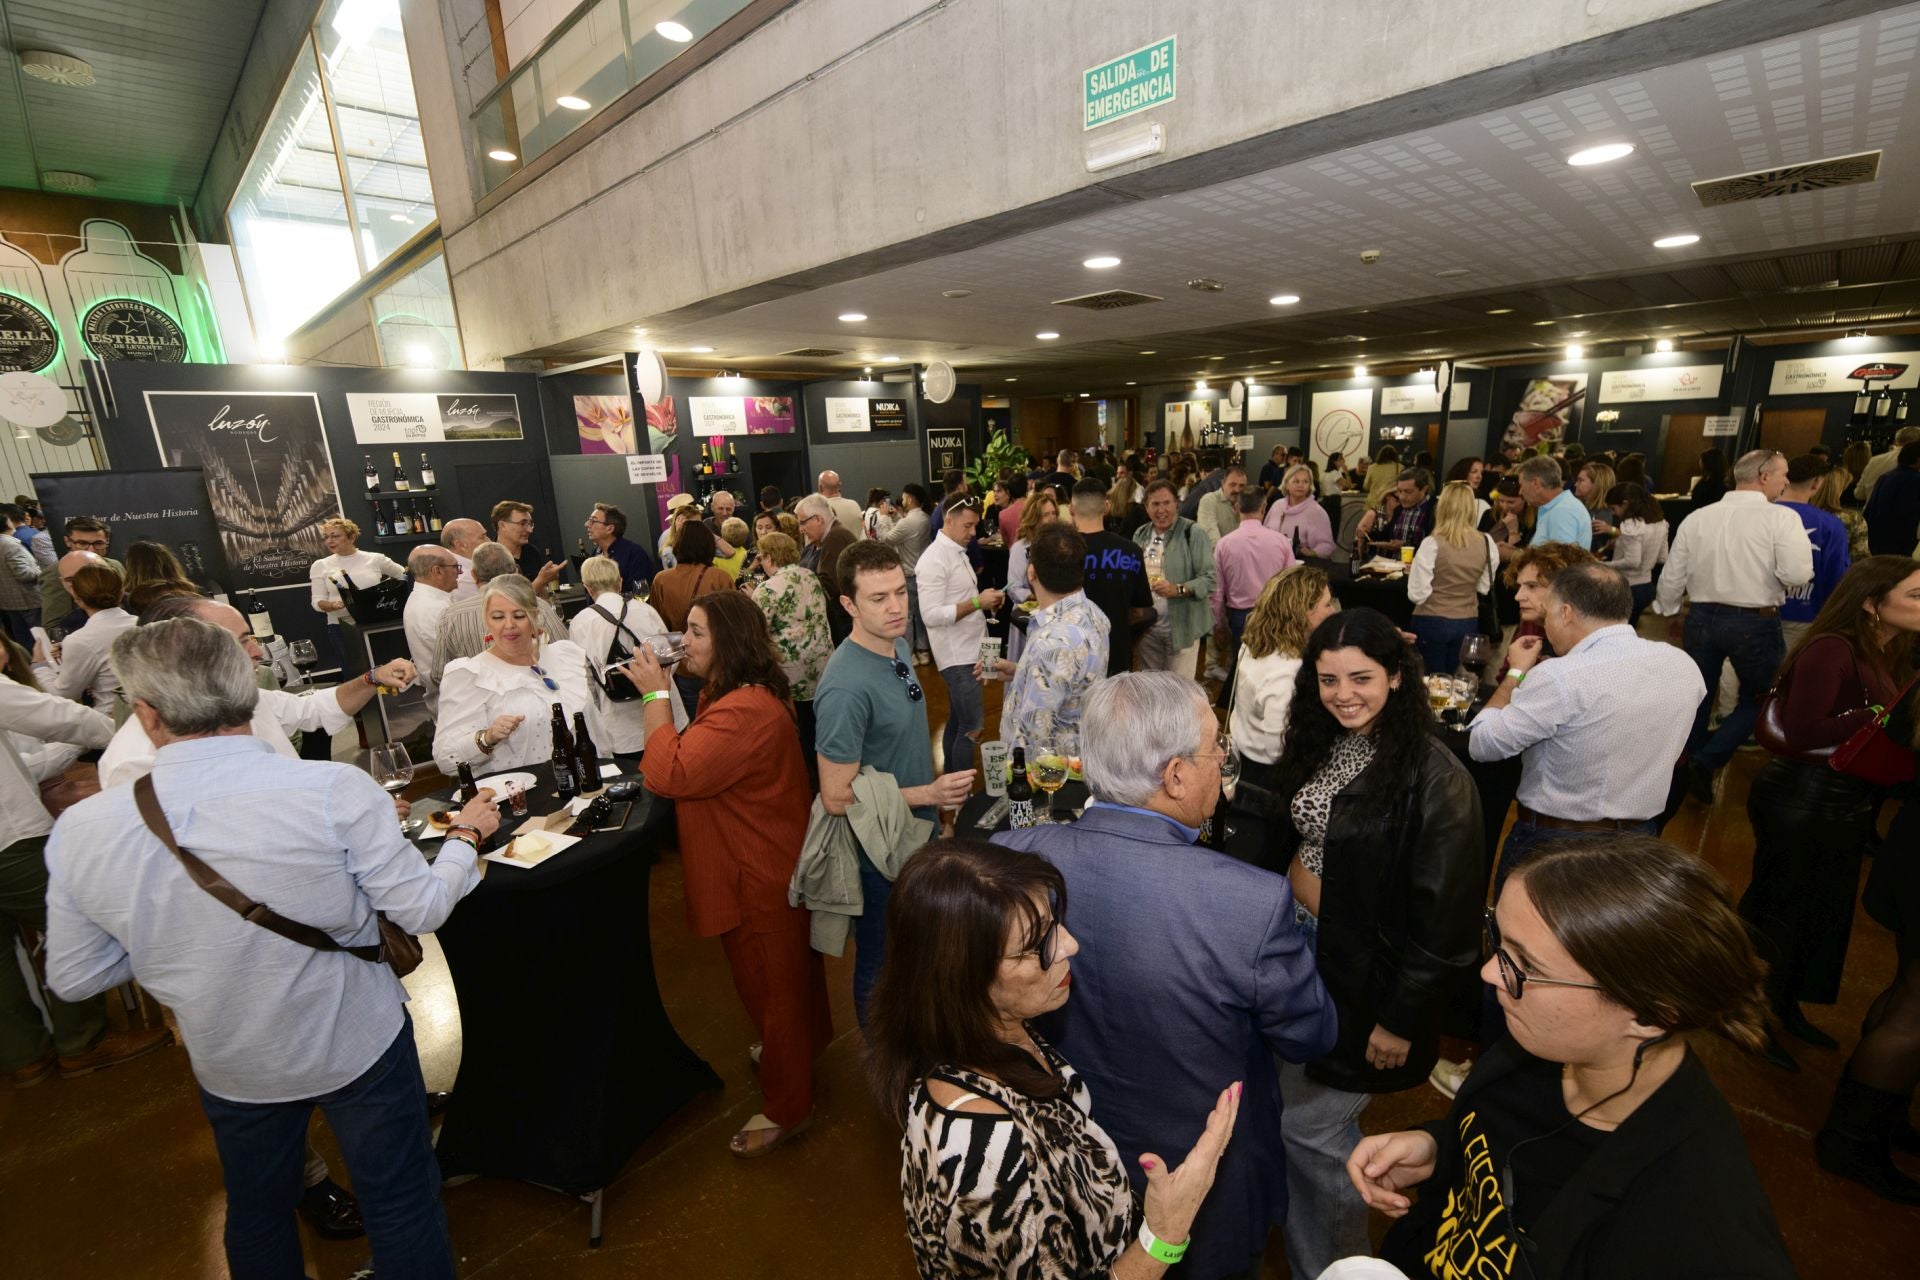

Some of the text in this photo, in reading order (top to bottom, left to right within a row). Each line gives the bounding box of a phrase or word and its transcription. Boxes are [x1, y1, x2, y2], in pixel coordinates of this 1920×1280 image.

[1090, 45, 1169, 96] SALIDA DE
[1087, 73, 1172, 122] EMERGENCIA
[0, 329, 52, 341] ELLA
[89, 333, 181, 346] ESTRELLA
[126, 343, 163, 351] LEVANTE
[367, 397, 391, 408] REGIÓN
[371, 413, 425, 423] GASTRONÓMICA
[373, 423, 391, 432] 2024
[110, 513, 121, 522] de
[122, 511, 159, 522] Nuestra
[162, 508, 198, 519] Historia
[262, 554, 283, 563] Sabor
[1101, 548, 1142, 574] Klein
[251, 561, 279, 573] Nuestra
[280, 558, 308, 568] Historia
